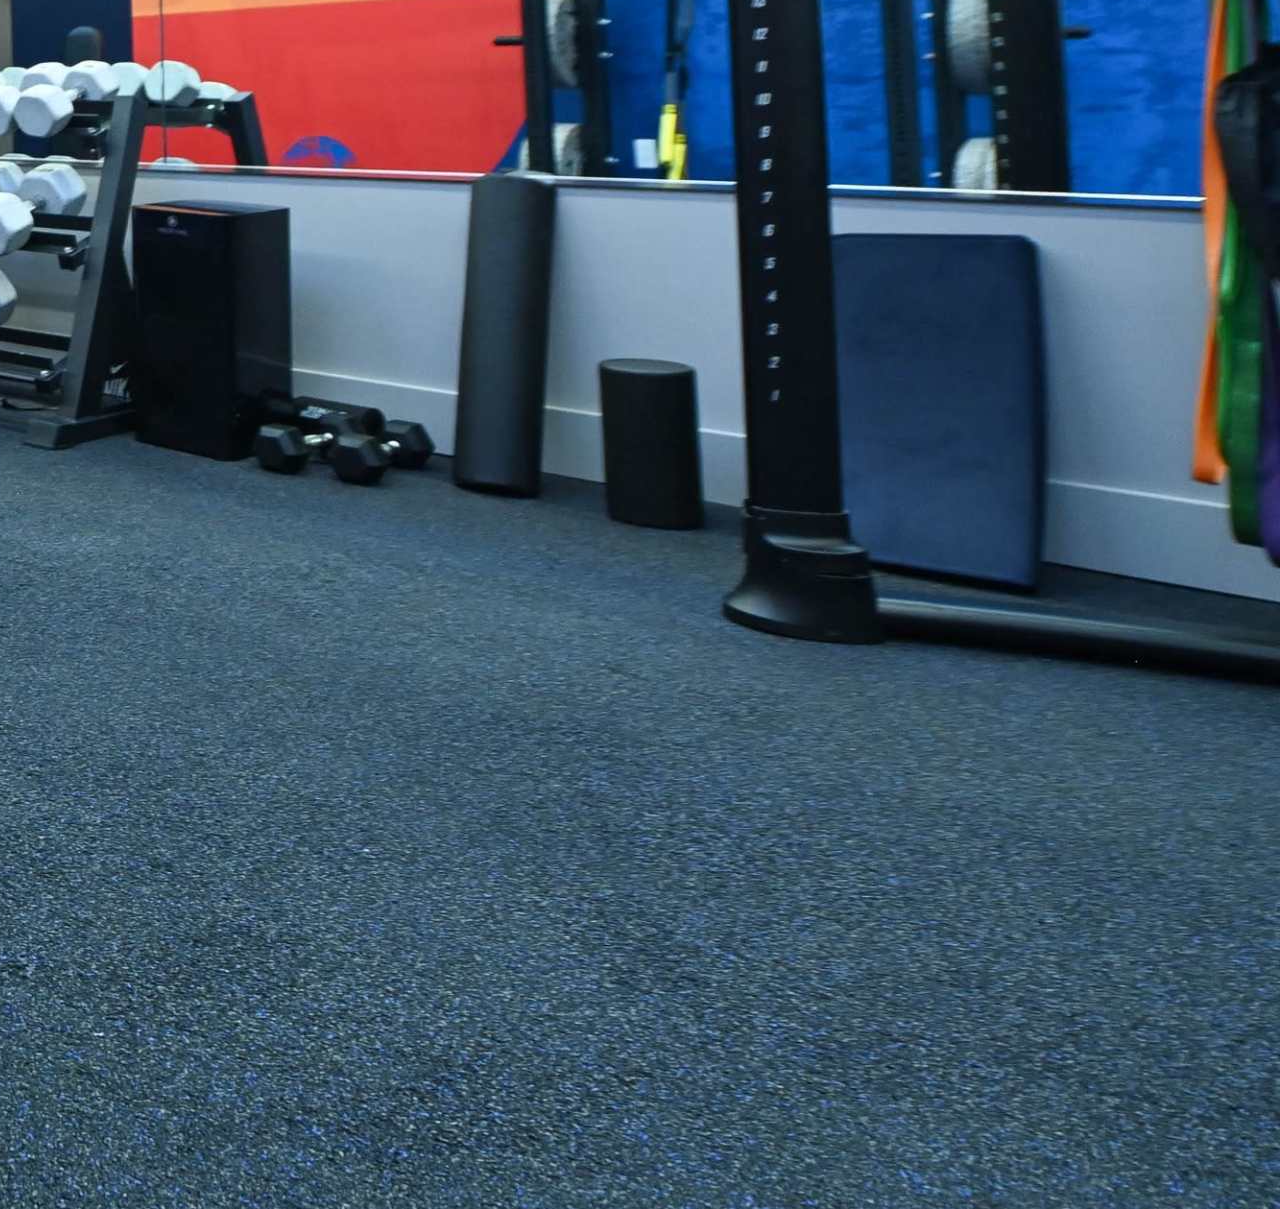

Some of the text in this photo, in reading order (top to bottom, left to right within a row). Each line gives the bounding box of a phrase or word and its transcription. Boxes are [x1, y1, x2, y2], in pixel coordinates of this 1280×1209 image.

[754, 28, 768, 40] 12
[756, 93, 771, 105] 10
[760, 126, 770, 138] 9
[761, 159, 772, 171] 8
[763, 192, 773, 203] 7
[763, 224, 775, 236] 6
[765, 257, 776, 269] 5
[767, 291, 776, 301] 4
[768, 323, 778, 335] 3
[769, 356, 780, 368] 2
[771, 390, 780, 401] 1
